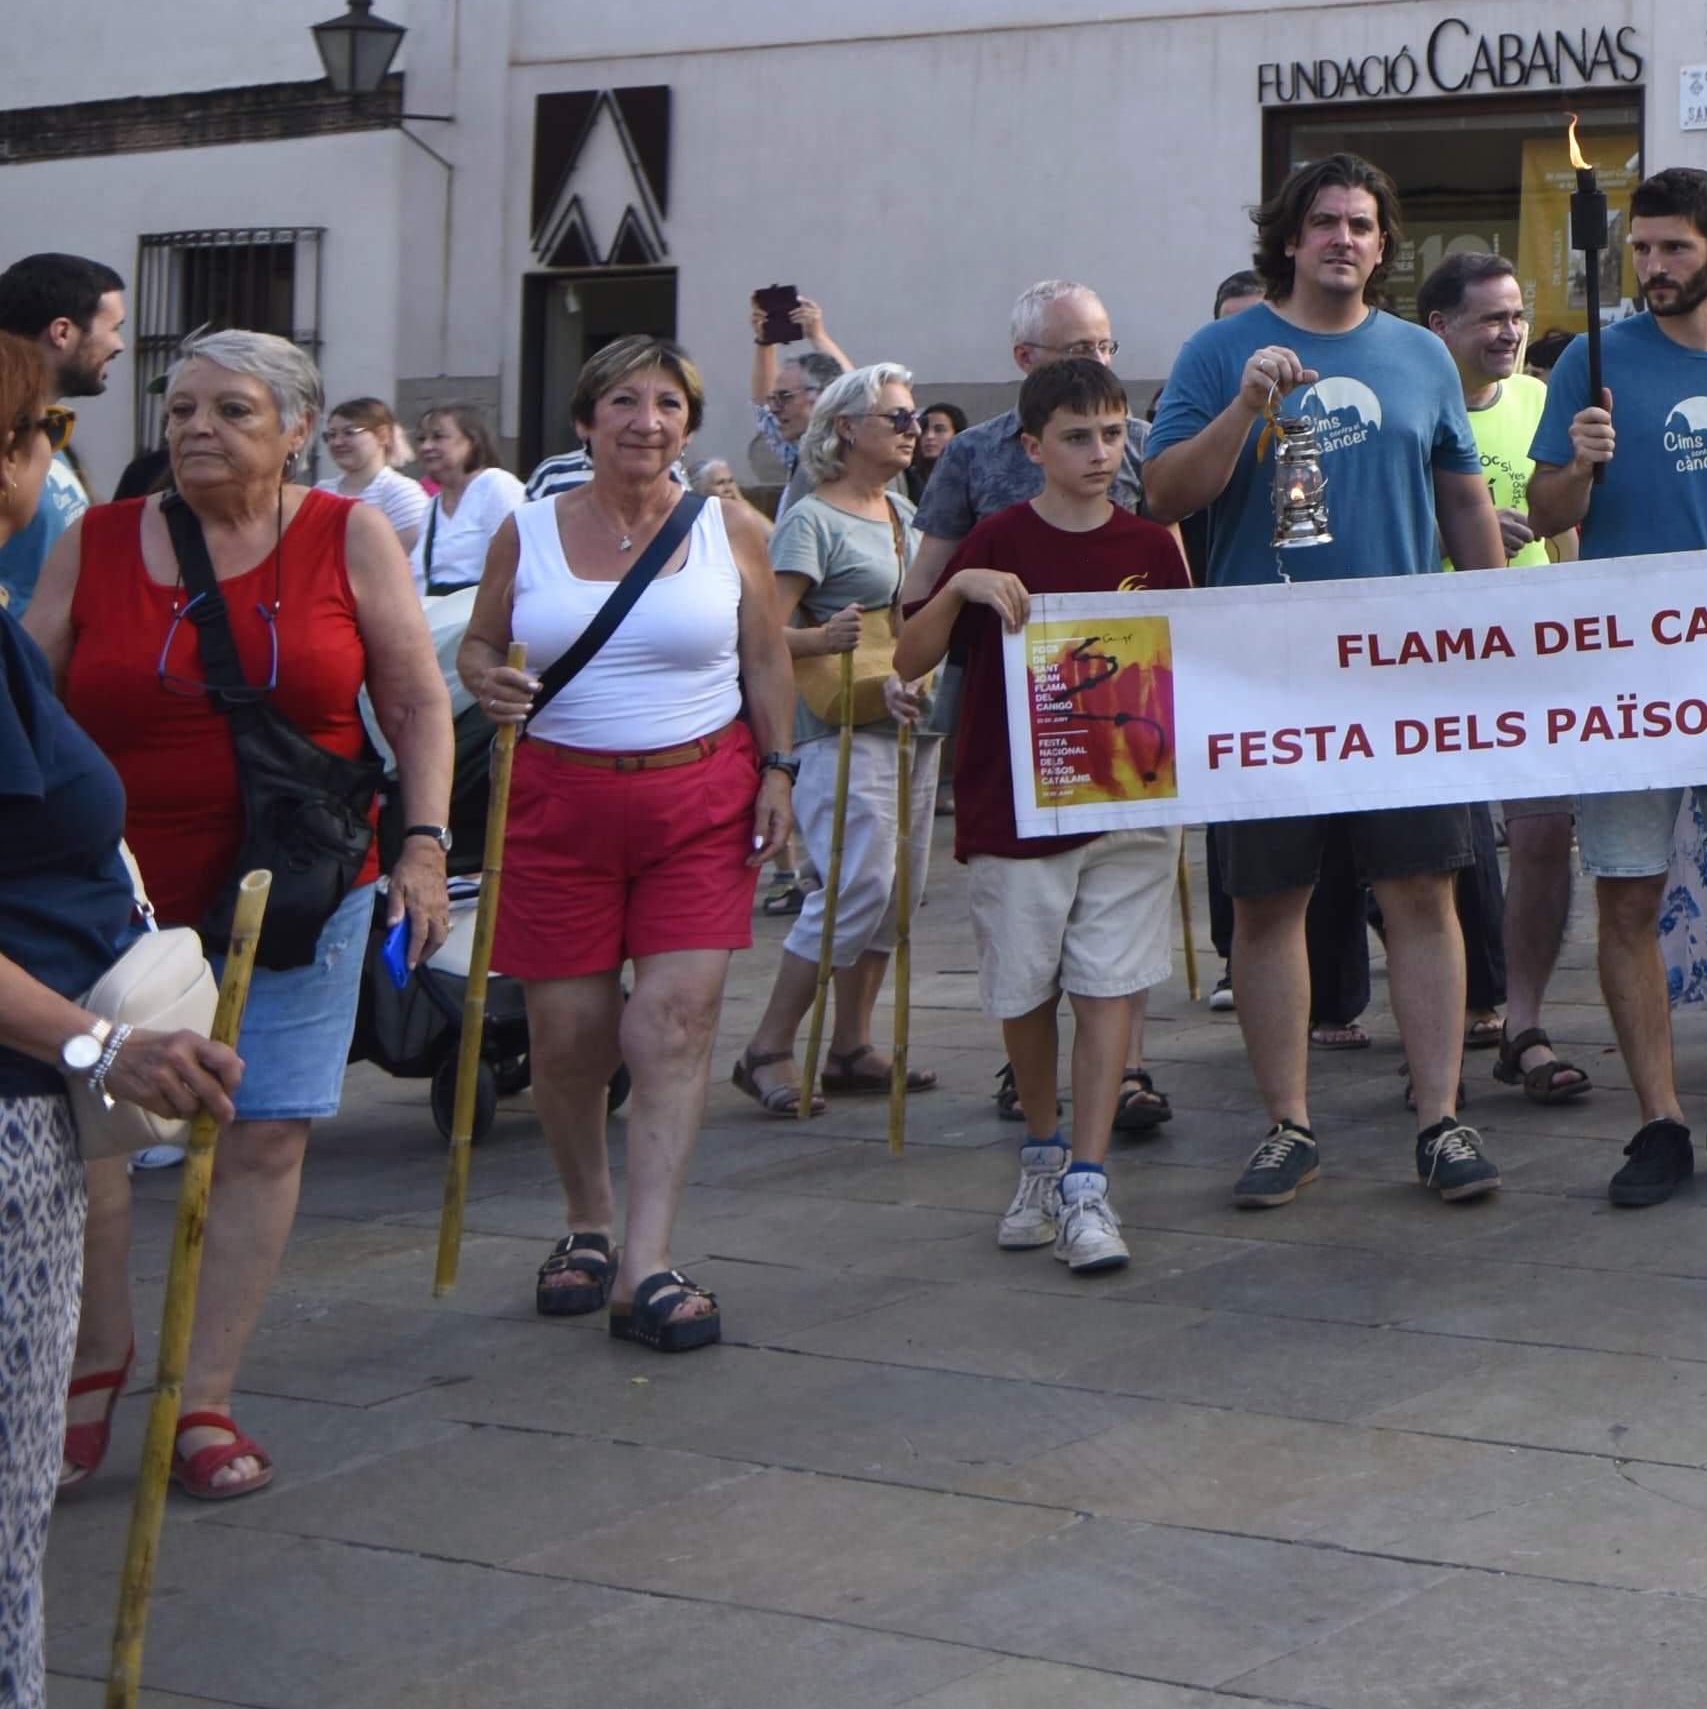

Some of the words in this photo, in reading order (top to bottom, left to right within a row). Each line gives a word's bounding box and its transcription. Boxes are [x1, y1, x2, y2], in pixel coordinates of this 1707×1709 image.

[1257, 45, 1418, 103] FUNDACIÓ
[1427, 18, 1643, 92] CABANAS
[1663, 431, 1704, 452] Cims
[1337, 625, 1515, 668] FLAMA
[1534, 615, 1634, 656] DEL
[1035, 683, 1067, 692] FLAMA
[1036, 693, 1053, 702] DEL
[1036, 700, 1073, 711] CANIGÓ
[1039, 738, 1067, 747] FESTA
[1206, 722, 1375, 770] FESTA
[1394, 710, 1527, 757] DELS
[1039, 747, 1087, 757] NACIONAL
[1041, 774, 1091, 786] CATALANS
